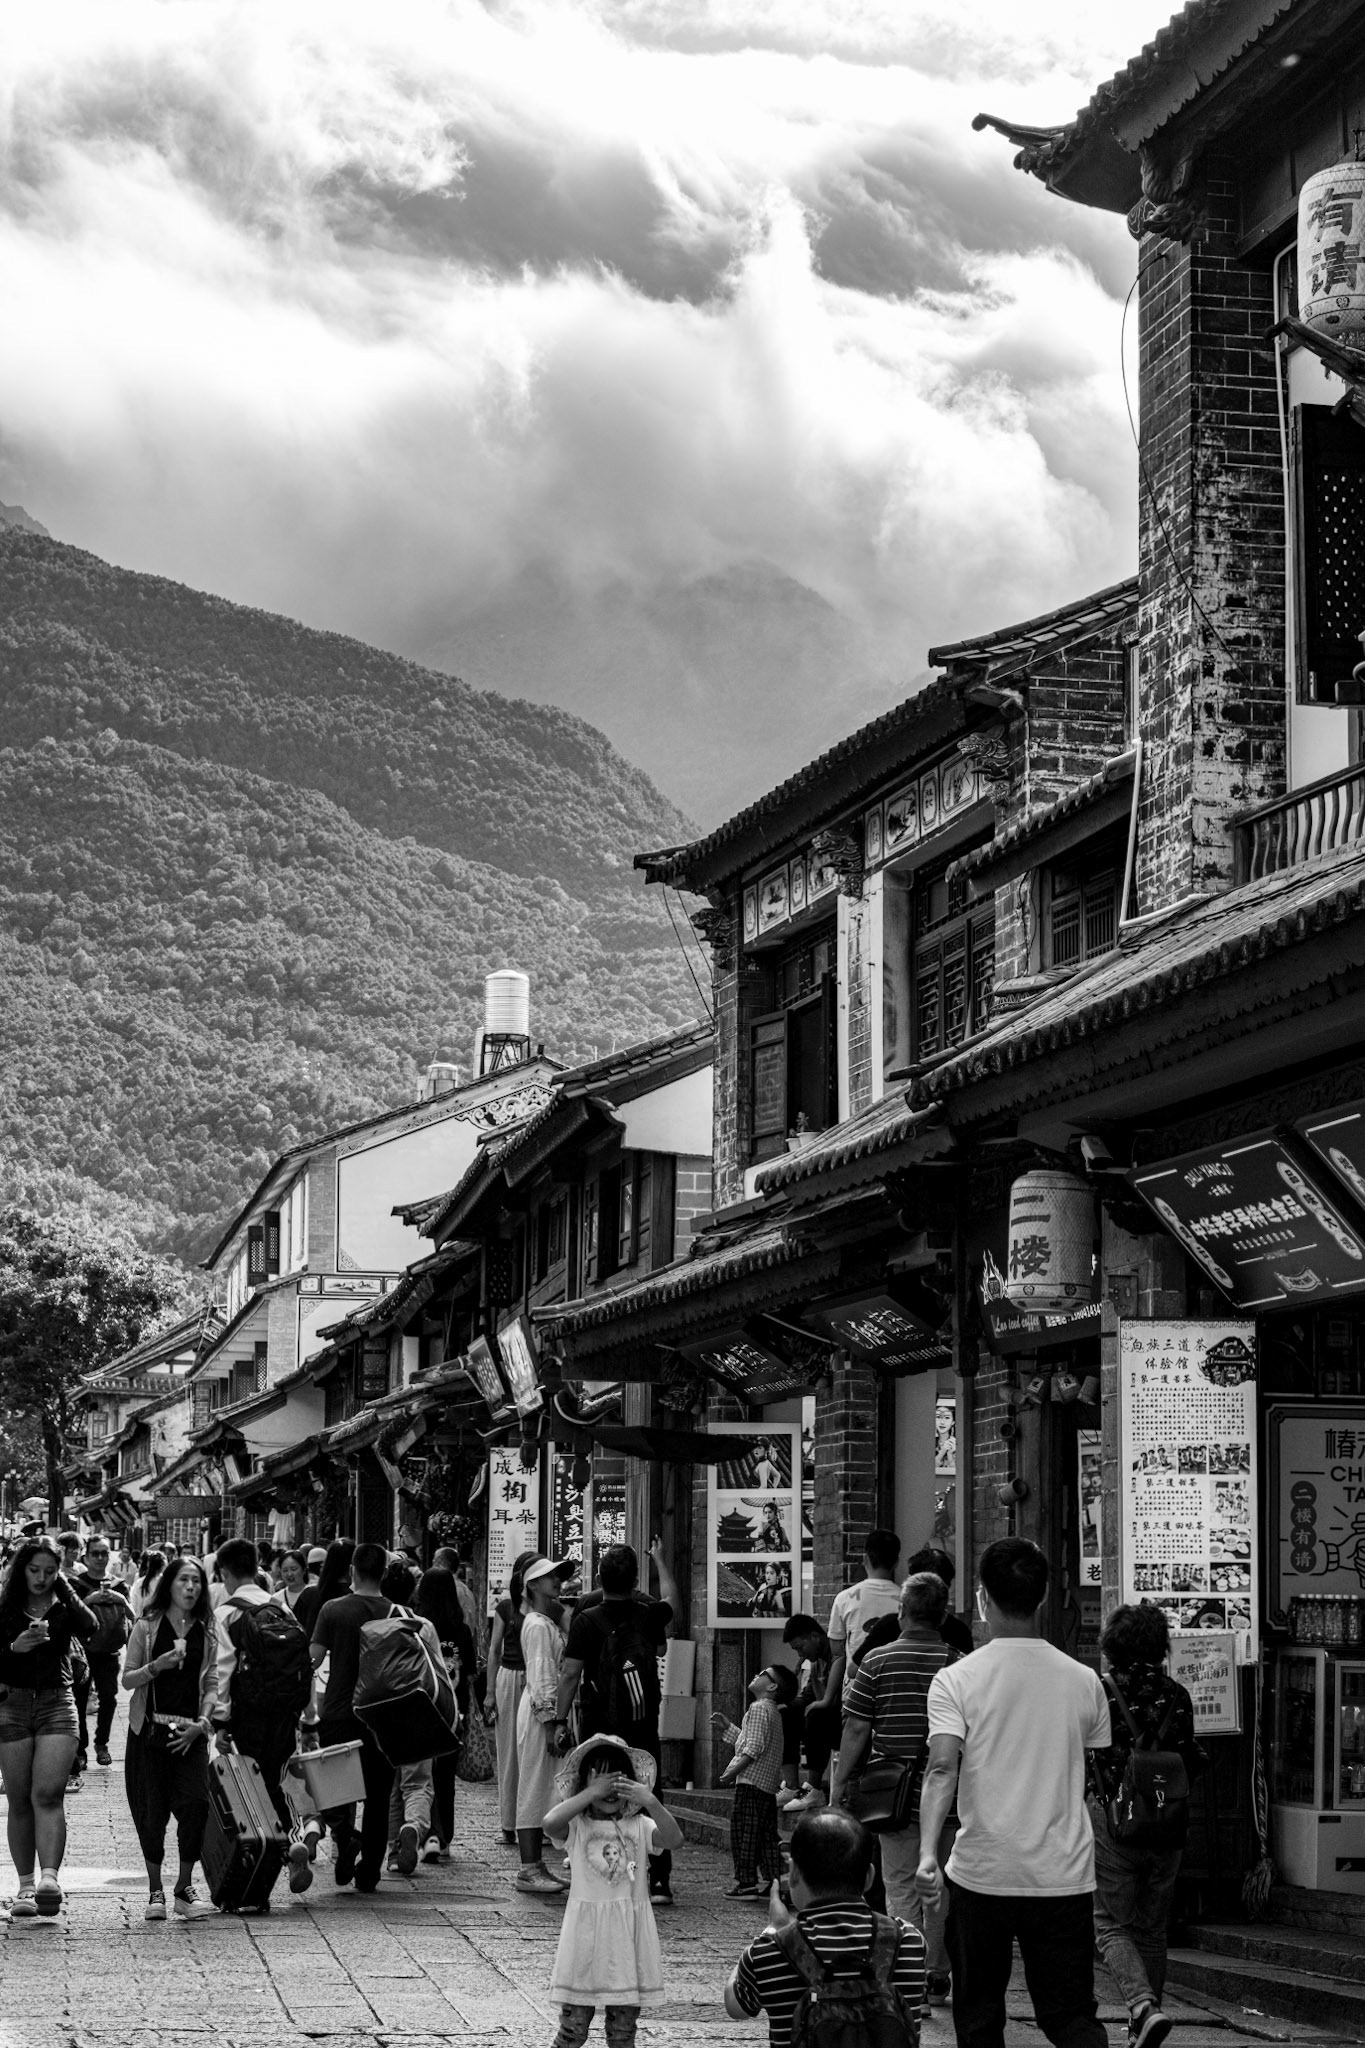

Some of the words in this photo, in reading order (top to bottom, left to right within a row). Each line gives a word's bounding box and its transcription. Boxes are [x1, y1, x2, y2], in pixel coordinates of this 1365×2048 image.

[1188, 1193, 1307, 1242] 中华老字号特色食品
[1009, 1195, 1051, 1281] 二楼
[1132, 1337, 1208, 1353] 白族三道茶
[1145, 1356, 1190, 1371] 体验馆
[501, 1479, 528, 1504] 掏
[491, 1508, 537, 1525] 耳朵
[1294, 1488, 1313, 1568] 二楼有请
